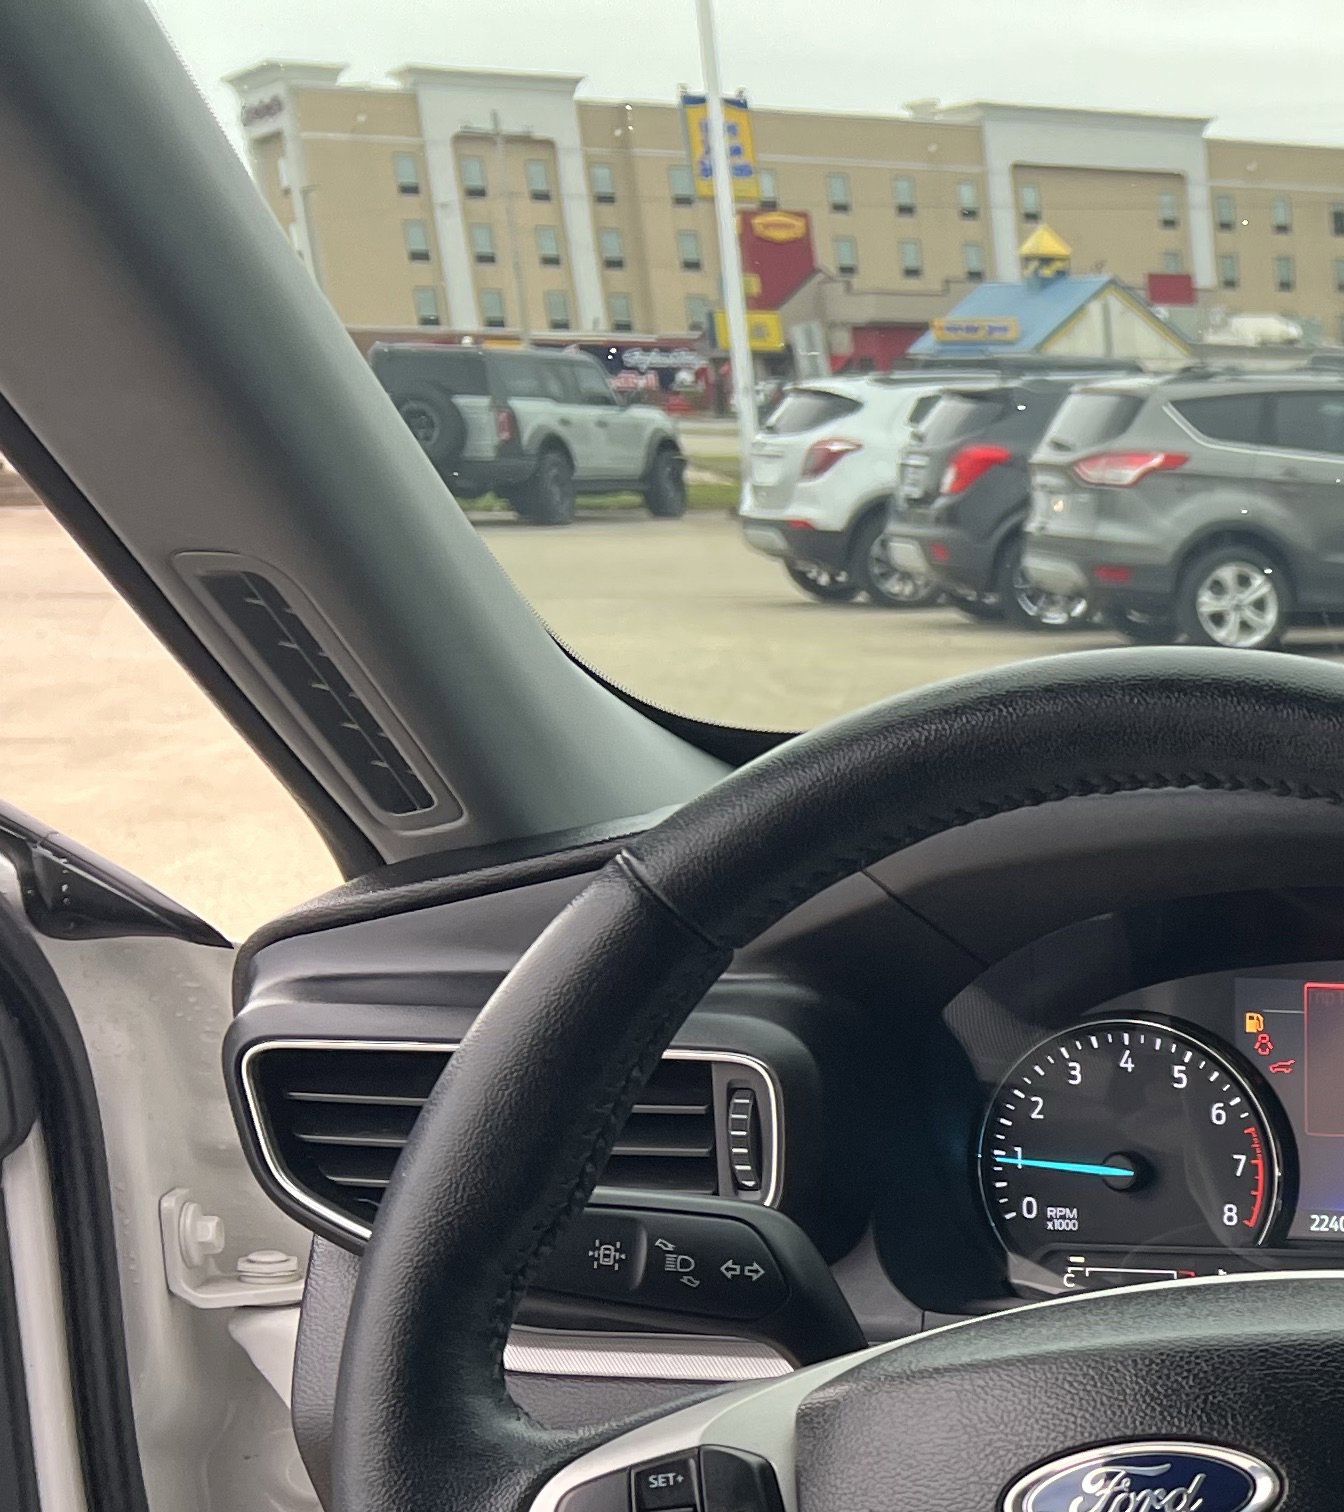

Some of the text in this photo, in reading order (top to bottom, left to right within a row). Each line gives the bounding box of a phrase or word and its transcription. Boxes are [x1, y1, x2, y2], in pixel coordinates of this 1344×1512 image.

[1119, 1051, 1135, 1072] 4
[1068, 1062, 1082, 1085] 3
[1173, 1066, 1188, 1089] 5
[1030, 1097, 1045, 1119] 2
[1211, 1103, 1226, 1125] 6
[1014, 1147, 1023, 1169] 1
[1233, 1155, 1246, 1176] 7
[1022, 1198, 1037, 1219] 0
[1046, 1207, 1078, 1220] RPM
[1223, 1204, 1238, 1226] 8
[1046, 1219, 1078, 1231] x1000
[649, 1473, 684, 1488] SET+
